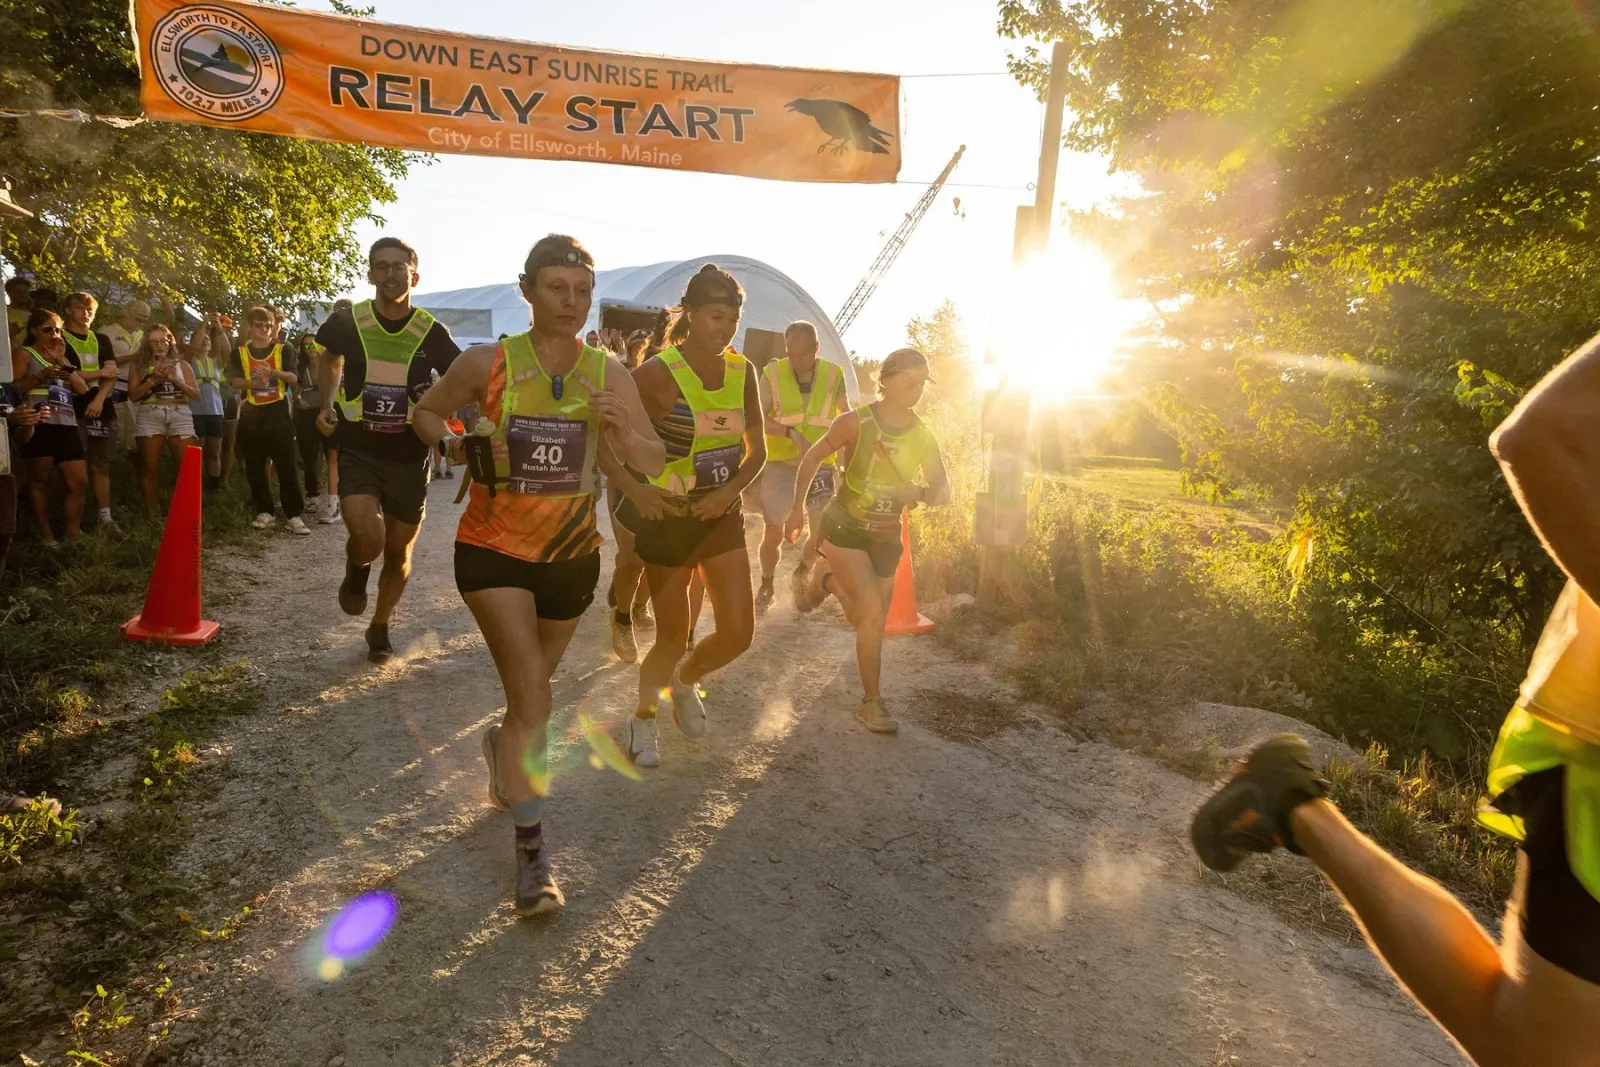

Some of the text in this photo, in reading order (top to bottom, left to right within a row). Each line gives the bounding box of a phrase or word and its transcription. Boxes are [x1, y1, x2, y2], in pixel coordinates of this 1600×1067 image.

[161, 13, 274, 70] ELLSWORTH TO EASTPORT
[360, 35, 734, 94] DOWN EAST SUNRISE TRAIL
[178, 85, 261, 113] 102.7 MILES
[328, 64, 756, 144] RELAY START
[428, 126, 683, 166] City of Ellsworth, Maine
[59, 394, 68, 403] 19
[376, 400, 396, 413] 37
[532, 436, 566, 444] Elizabeth
[531, 445, 563, 465] 40
[523, 463, 548, 471] Bustah
[712, 466, 729, 483] 19
[875, 499, 893, 513] 32
